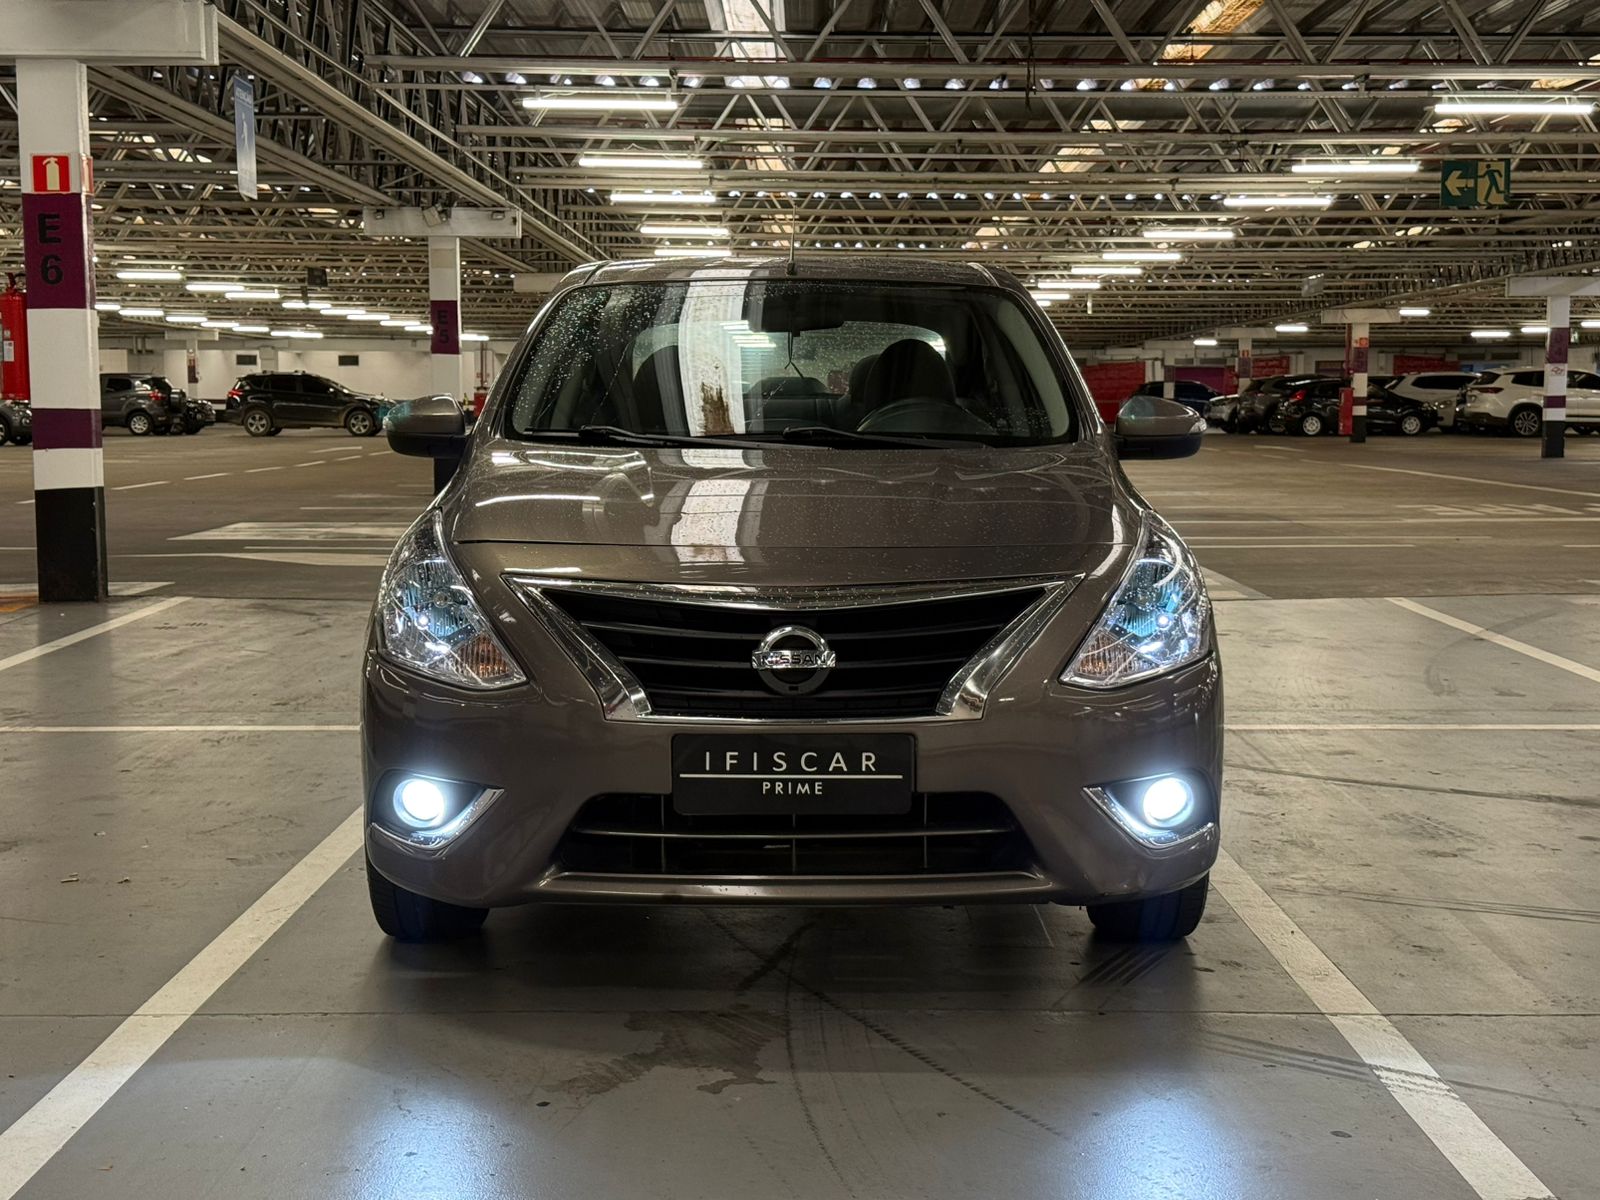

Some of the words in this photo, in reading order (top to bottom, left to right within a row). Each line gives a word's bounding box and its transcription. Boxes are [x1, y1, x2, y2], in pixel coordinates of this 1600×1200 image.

[38, 213, 61, 243] E
[41, 254, 64, 285] 6
[761, 654, 826, 665] NISSAN
[705, 751, 877, 772] IFISCAR
[762, 781, 823, 795] PRIME
